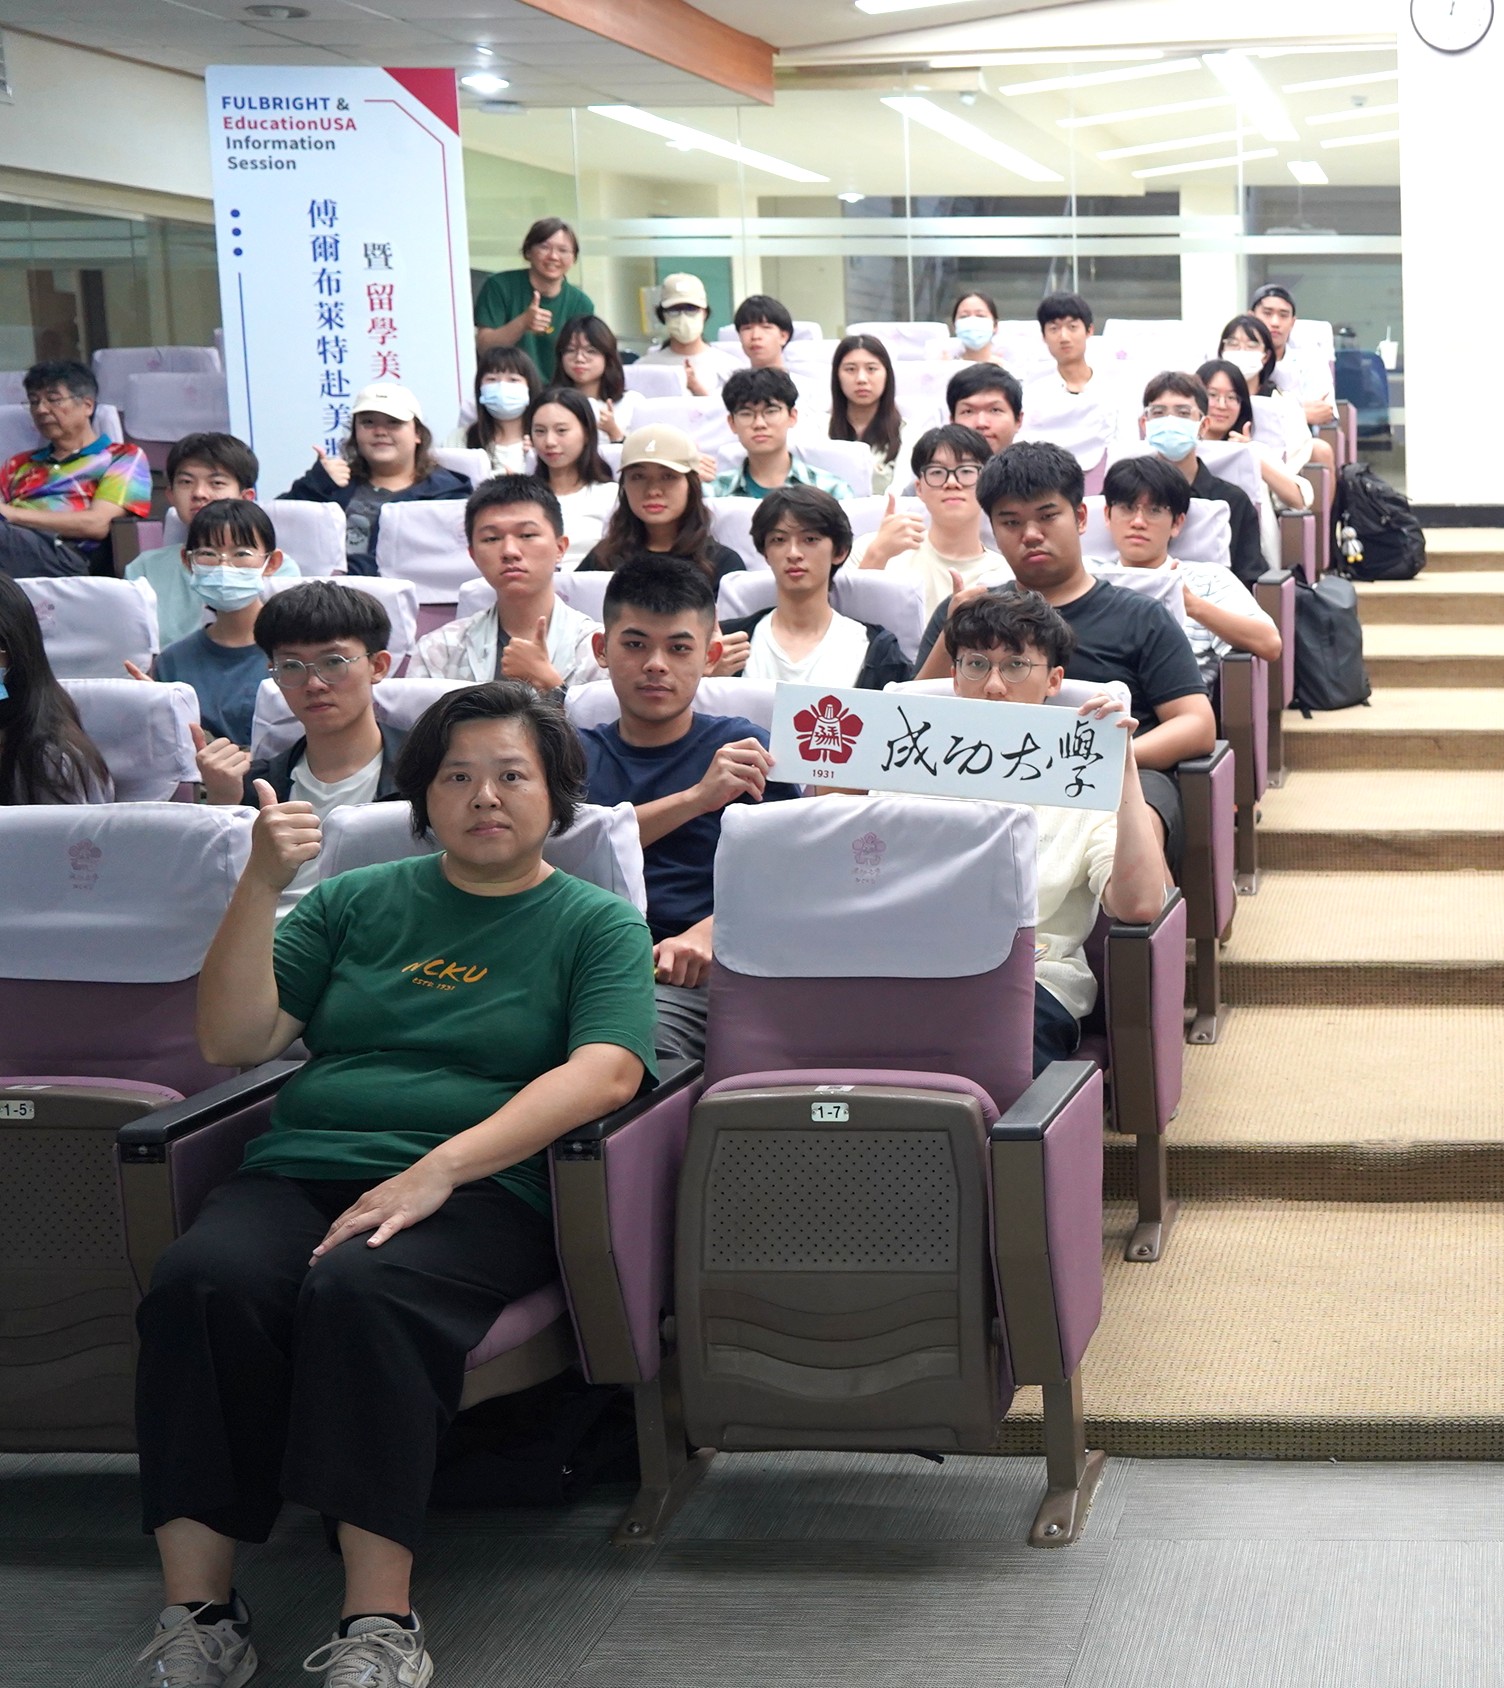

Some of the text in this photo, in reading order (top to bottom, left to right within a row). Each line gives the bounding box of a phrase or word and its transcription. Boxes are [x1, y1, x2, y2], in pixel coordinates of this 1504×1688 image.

[221, 96, 350, 111] FULBRIGHT &
[223, 116, 357, 131] EducationUSA
[226, 136, 336, 150] Information
[227, 155, 297, 170] Session
[881, 706, 1104, 798] 成功大學
[812, 769, 835, 779] 1931
[401, 959, 488, 983] NCKU
[4, 1103, 27, 1116] 1-5
[818, 1106, 841, 1118] 1-7
